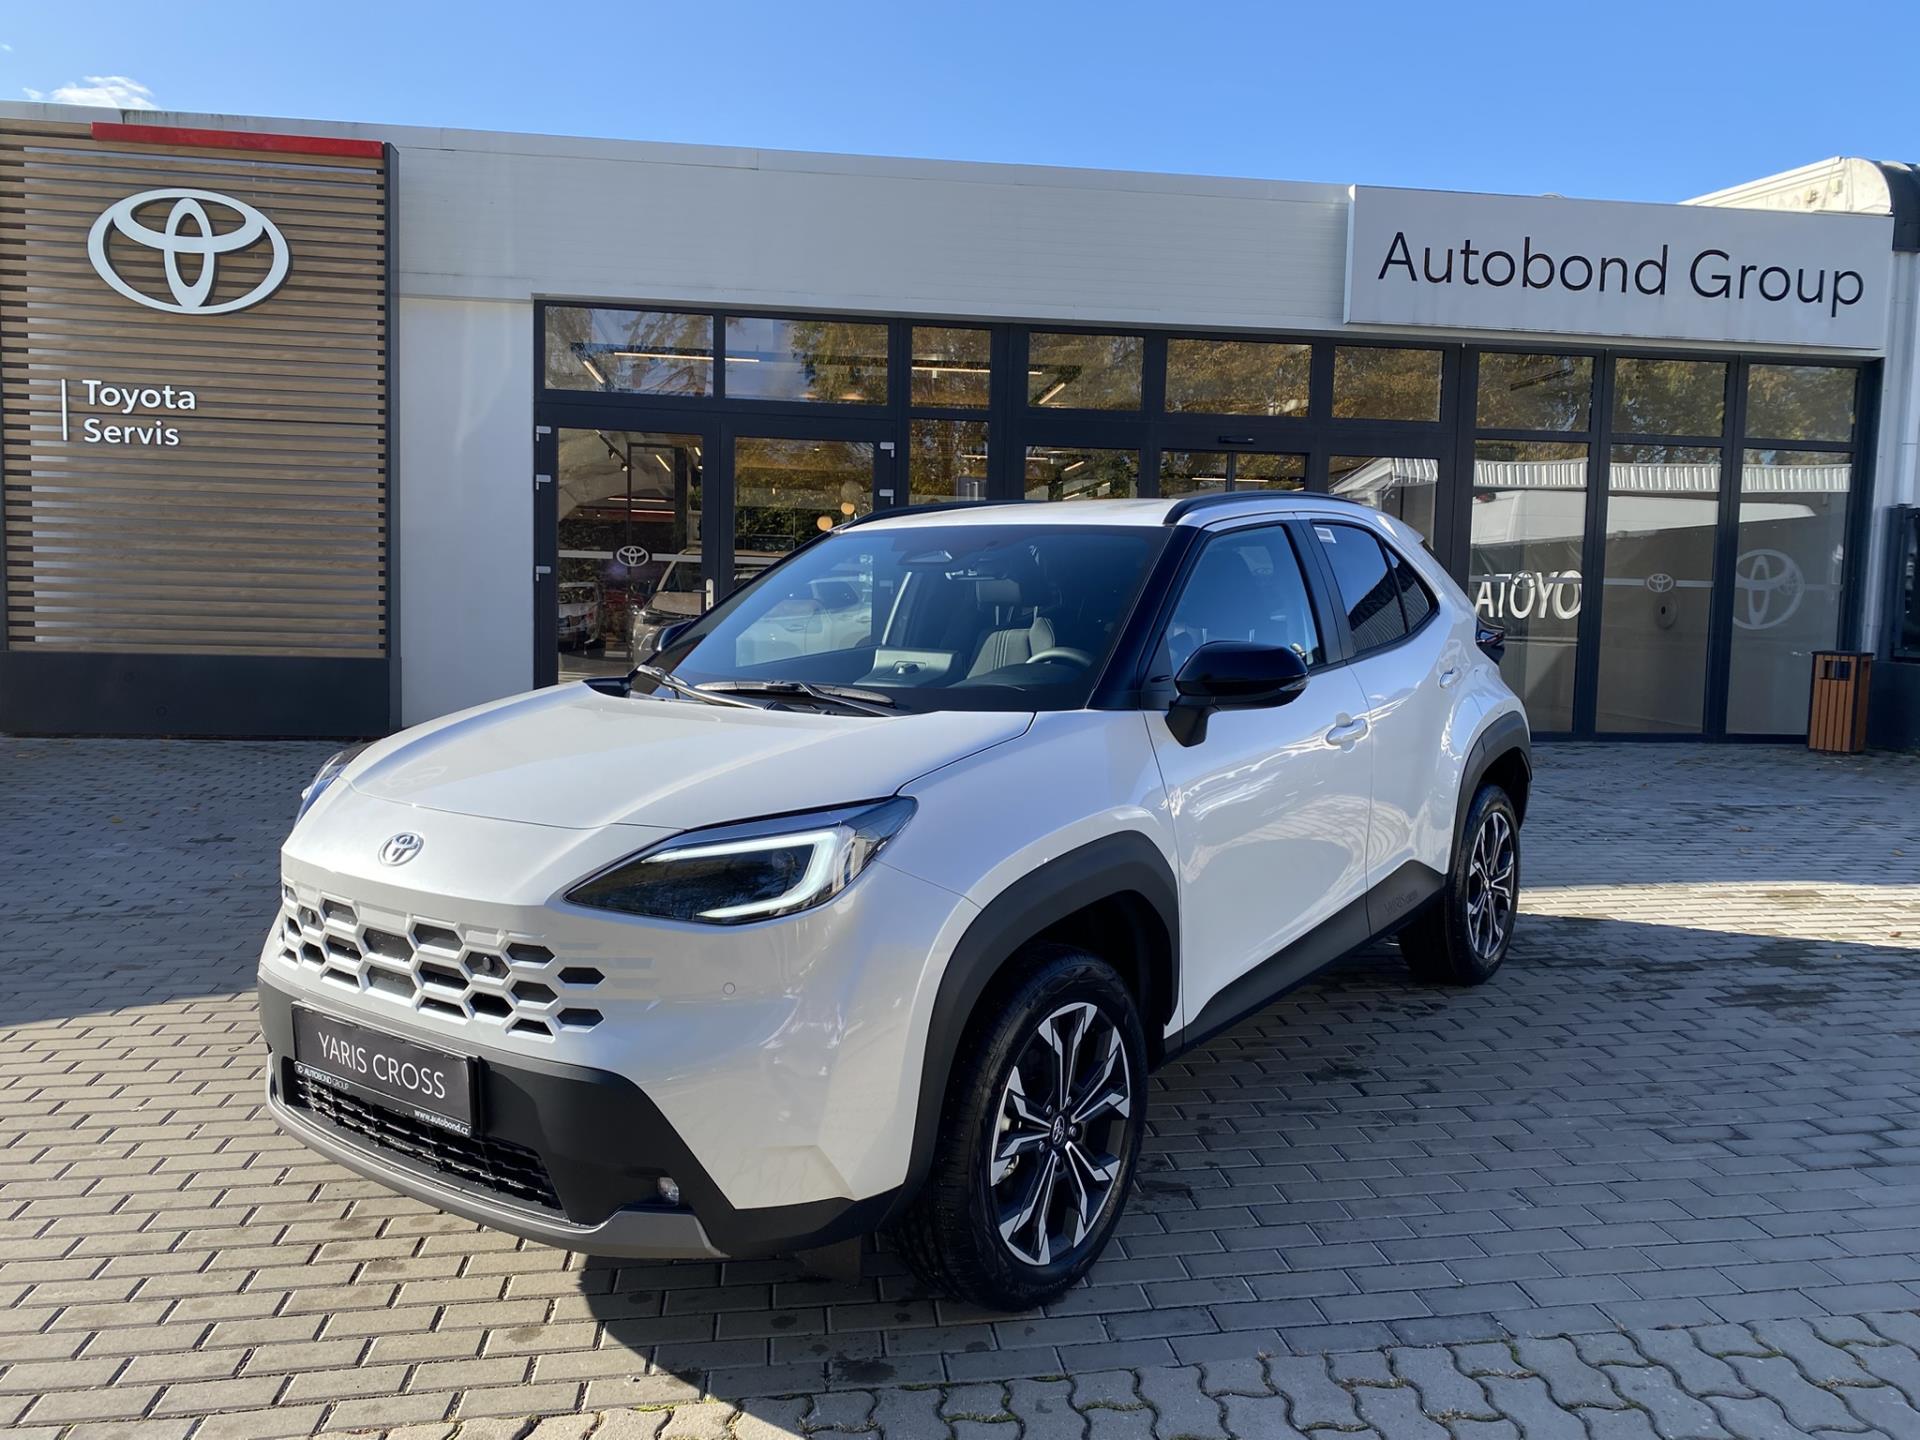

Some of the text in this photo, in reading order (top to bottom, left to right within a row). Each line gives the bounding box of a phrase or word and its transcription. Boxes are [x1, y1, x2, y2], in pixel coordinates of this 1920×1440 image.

[1377, 231, 1865, 318] Autobond Group
[82, 379, 196, 414] Toyota
[83, 418, 180, 446] Servis
[318, 1031, 446, 1099] YARIS CROSS
[414, 1109, 469, 1136] www.autobond.cz
